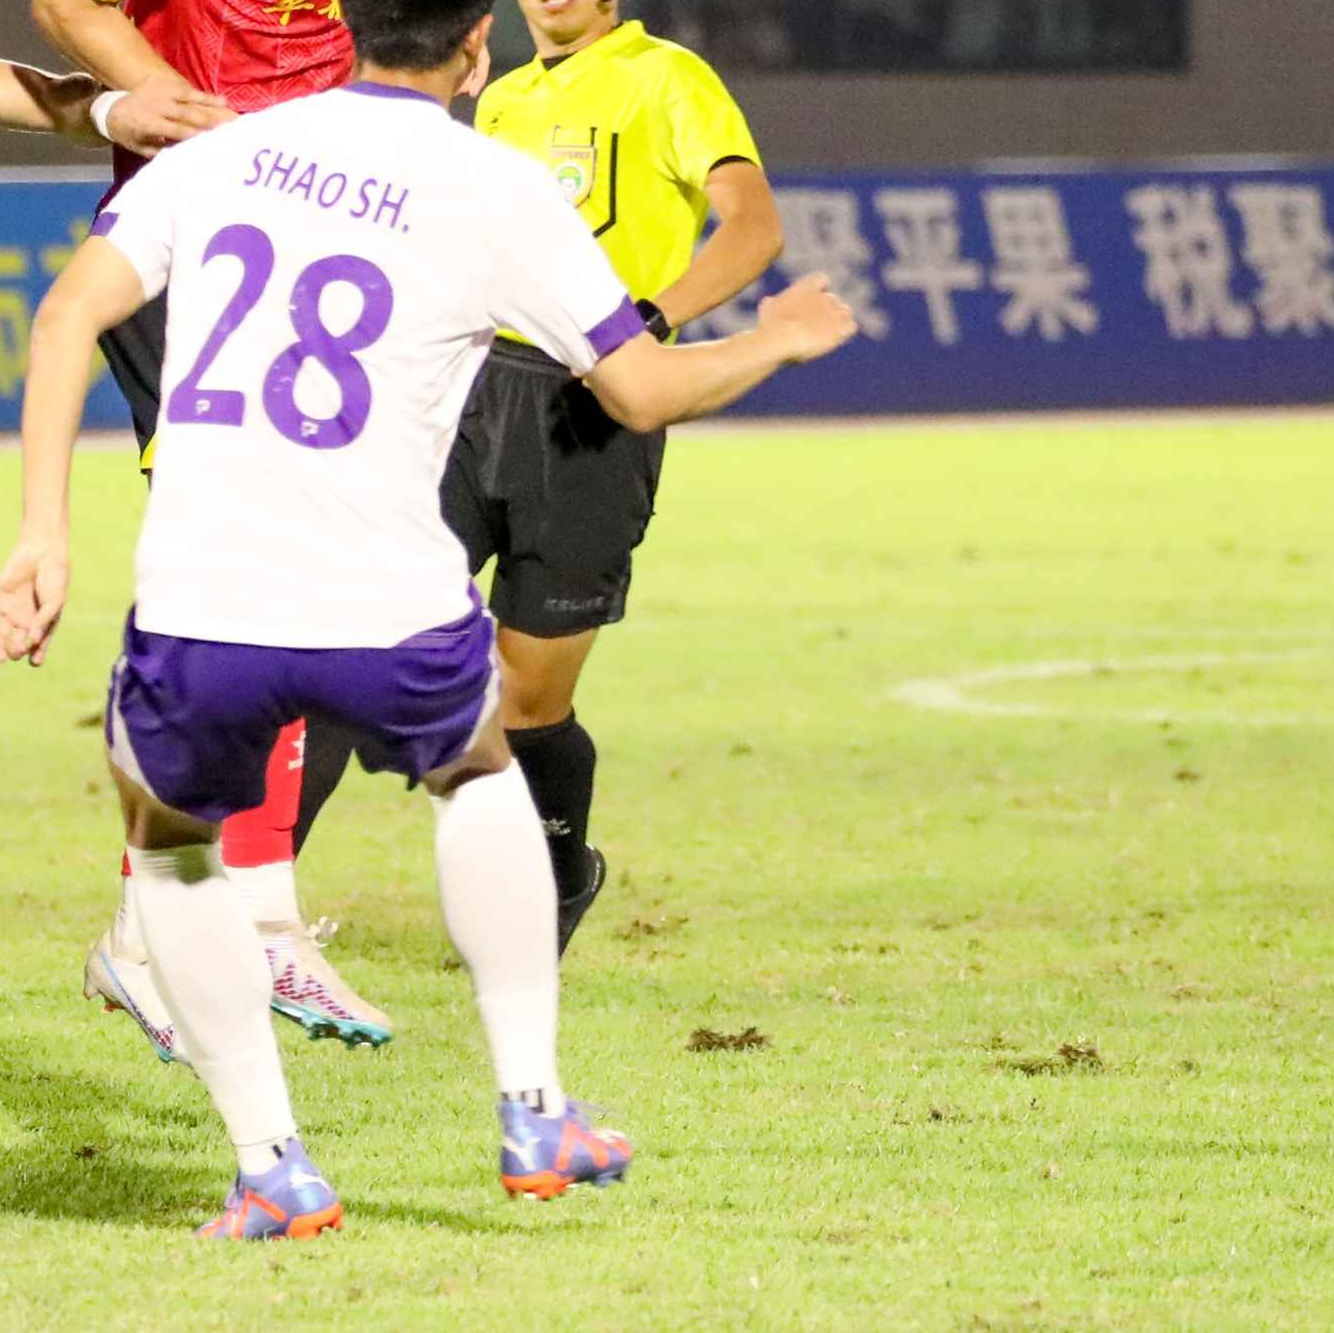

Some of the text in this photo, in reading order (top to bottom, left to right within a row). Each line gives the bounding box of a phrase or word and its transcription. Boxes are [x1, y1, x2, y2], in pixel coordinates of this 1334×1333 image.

[243, 148, 412, 234] SHAO SH.
[167, 223, 395, 450] 28
